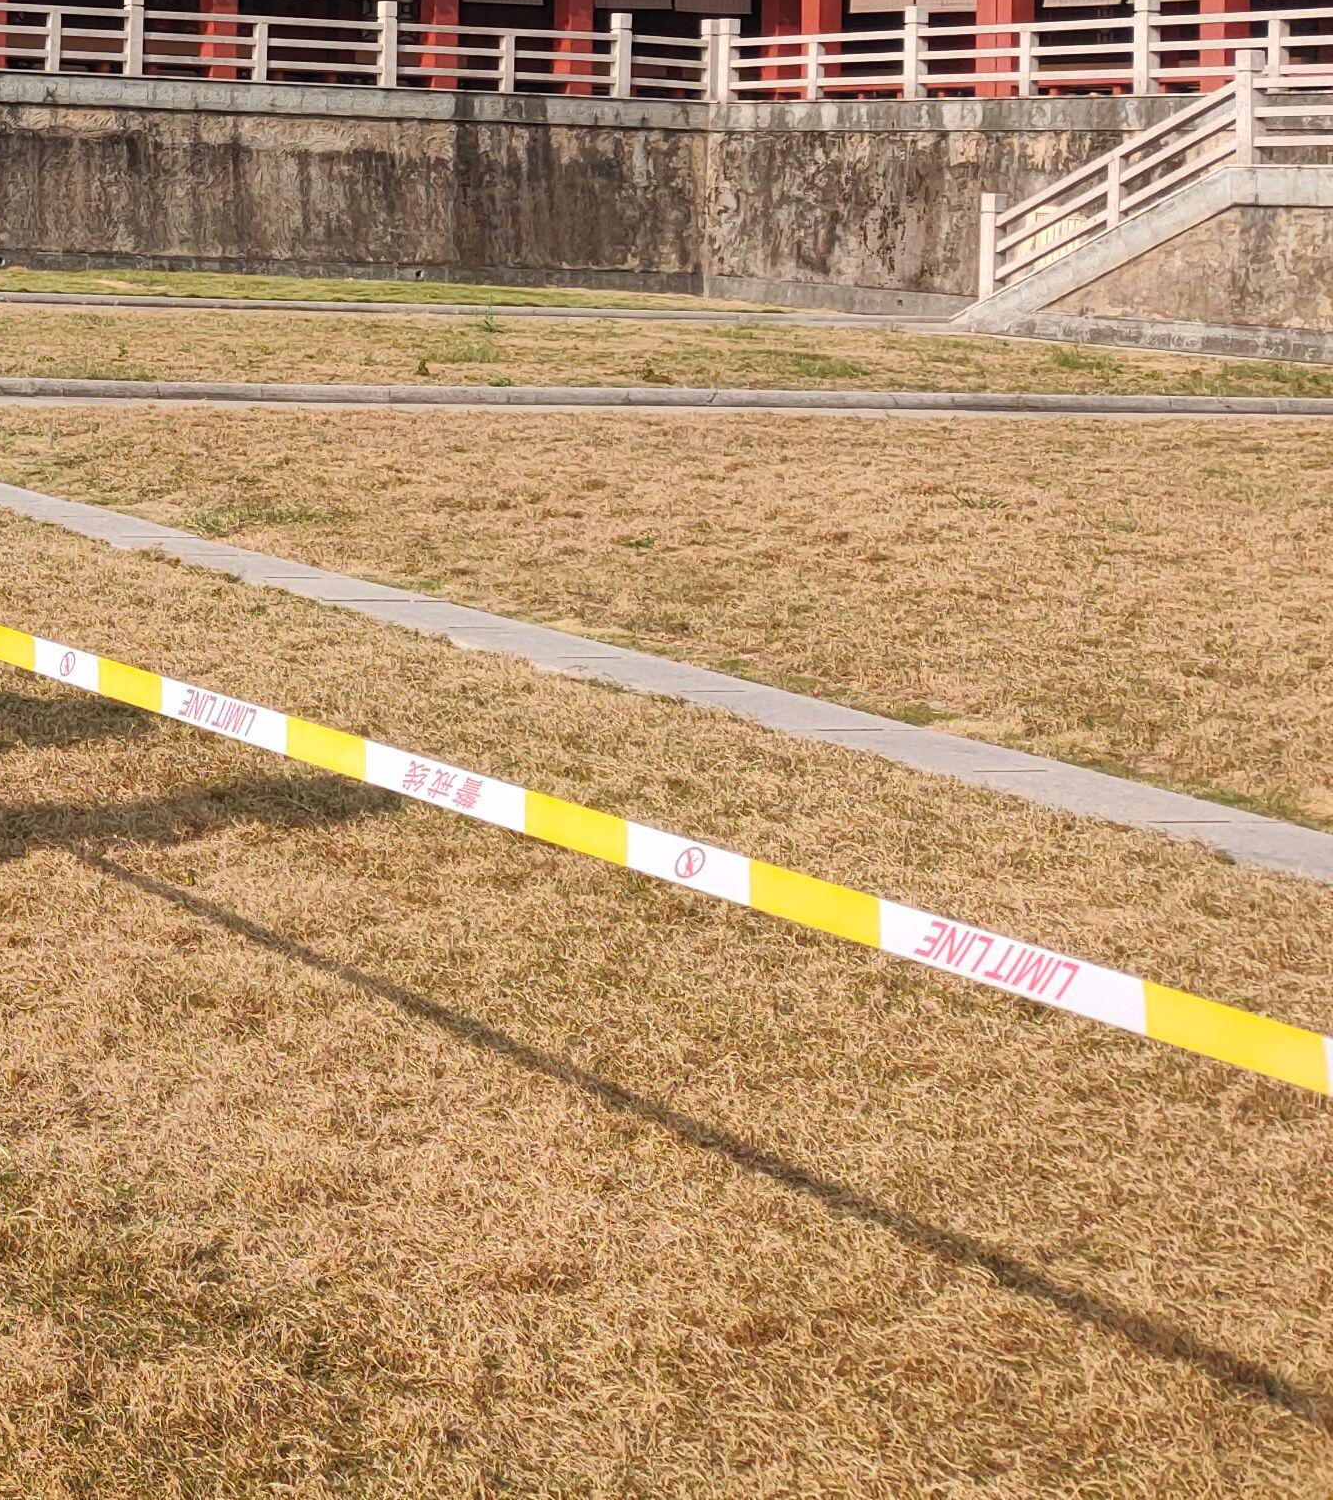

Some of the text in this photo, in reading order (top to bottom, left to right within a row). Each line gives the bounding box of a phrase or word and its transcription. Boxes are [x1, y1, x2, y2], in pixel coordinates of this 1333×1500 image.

[178, 689, 257, 737] LIMIT LINE
[402, 761, 483, 809] 警戒线
[915, 920, 1081, 1001] LIMIT LINE
